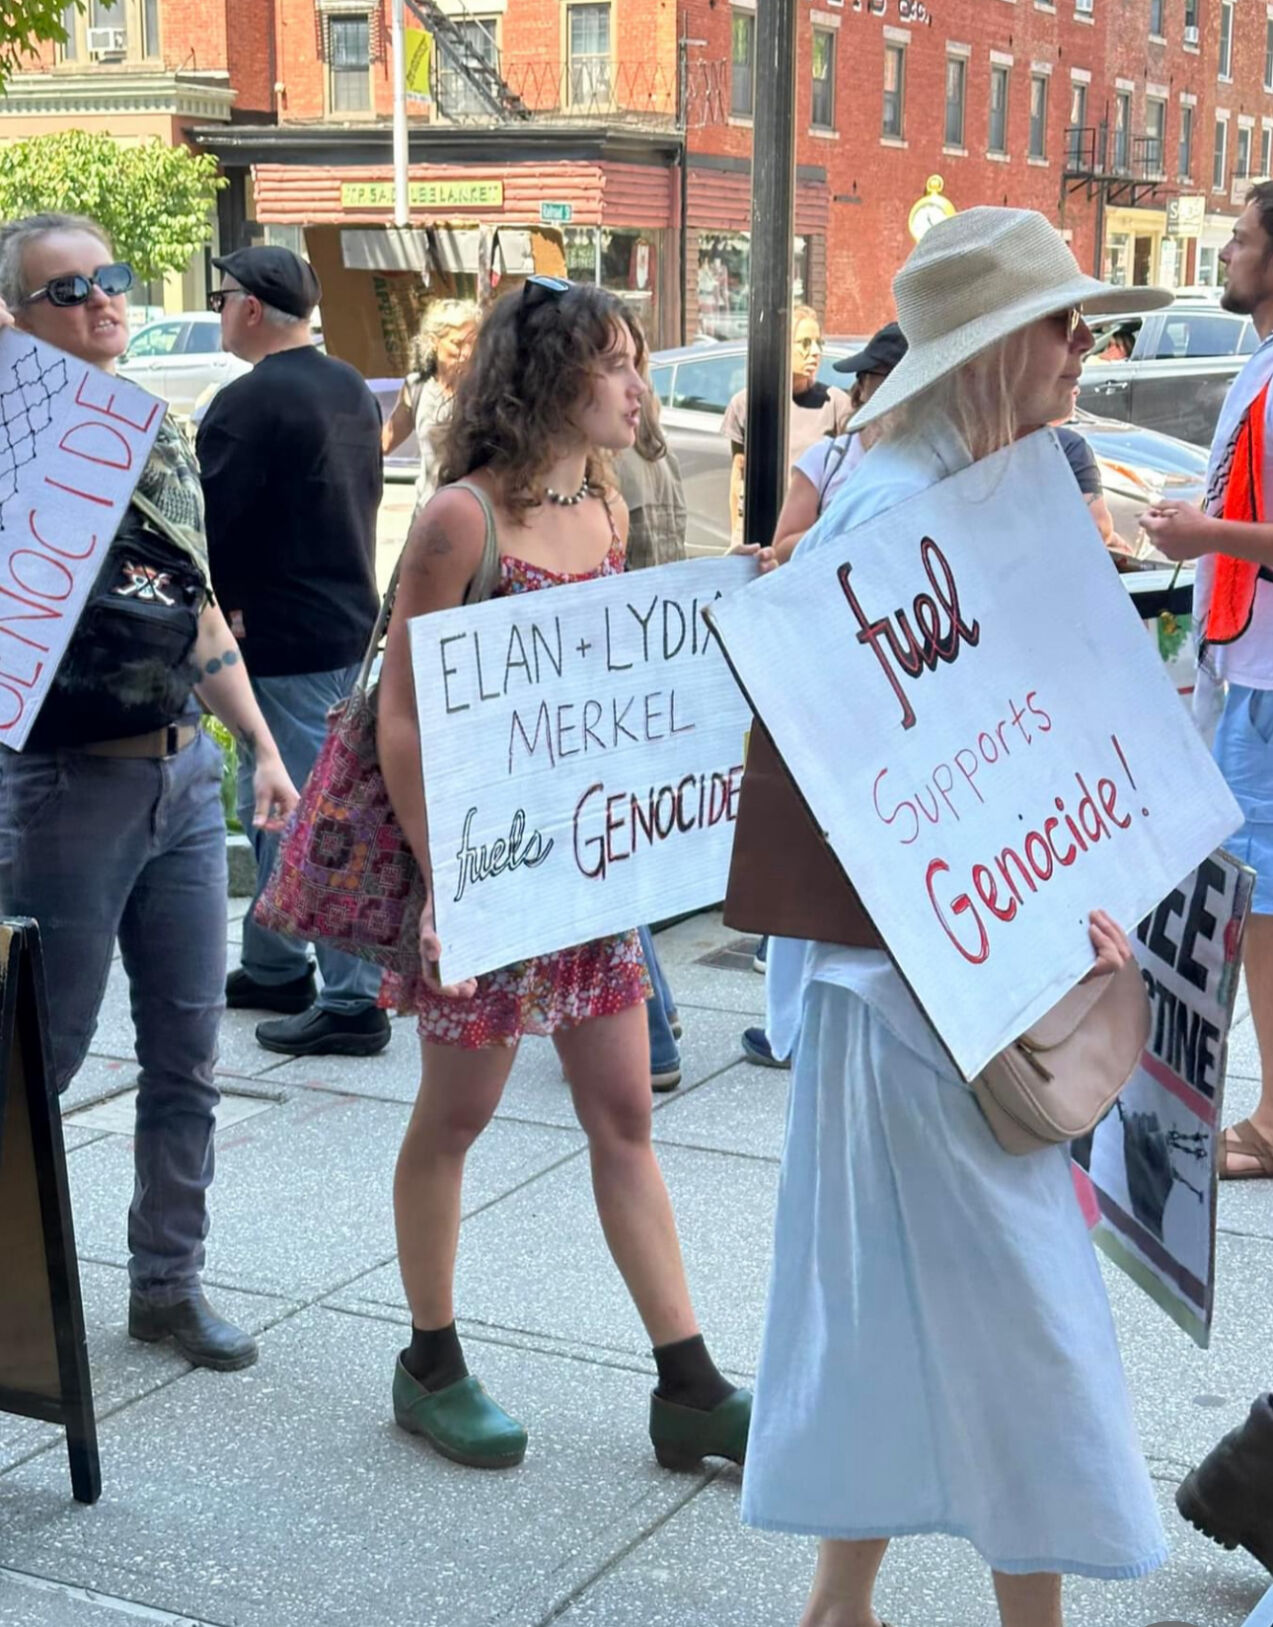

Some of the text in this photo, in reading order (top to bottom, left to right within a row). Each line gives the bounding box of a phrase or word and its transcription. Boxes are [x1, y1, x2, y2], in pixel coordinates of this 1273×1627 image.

[440, 616, 562, 714] ELAN
[576, 638, 592, 658] +
[836, 536, 980, 730] fuel
[508, 689, 696, 774] MERKEL
[454, 765, 744, 902] fuels GENOCIDE
[925, 734, 1150, 965] Genocide!
